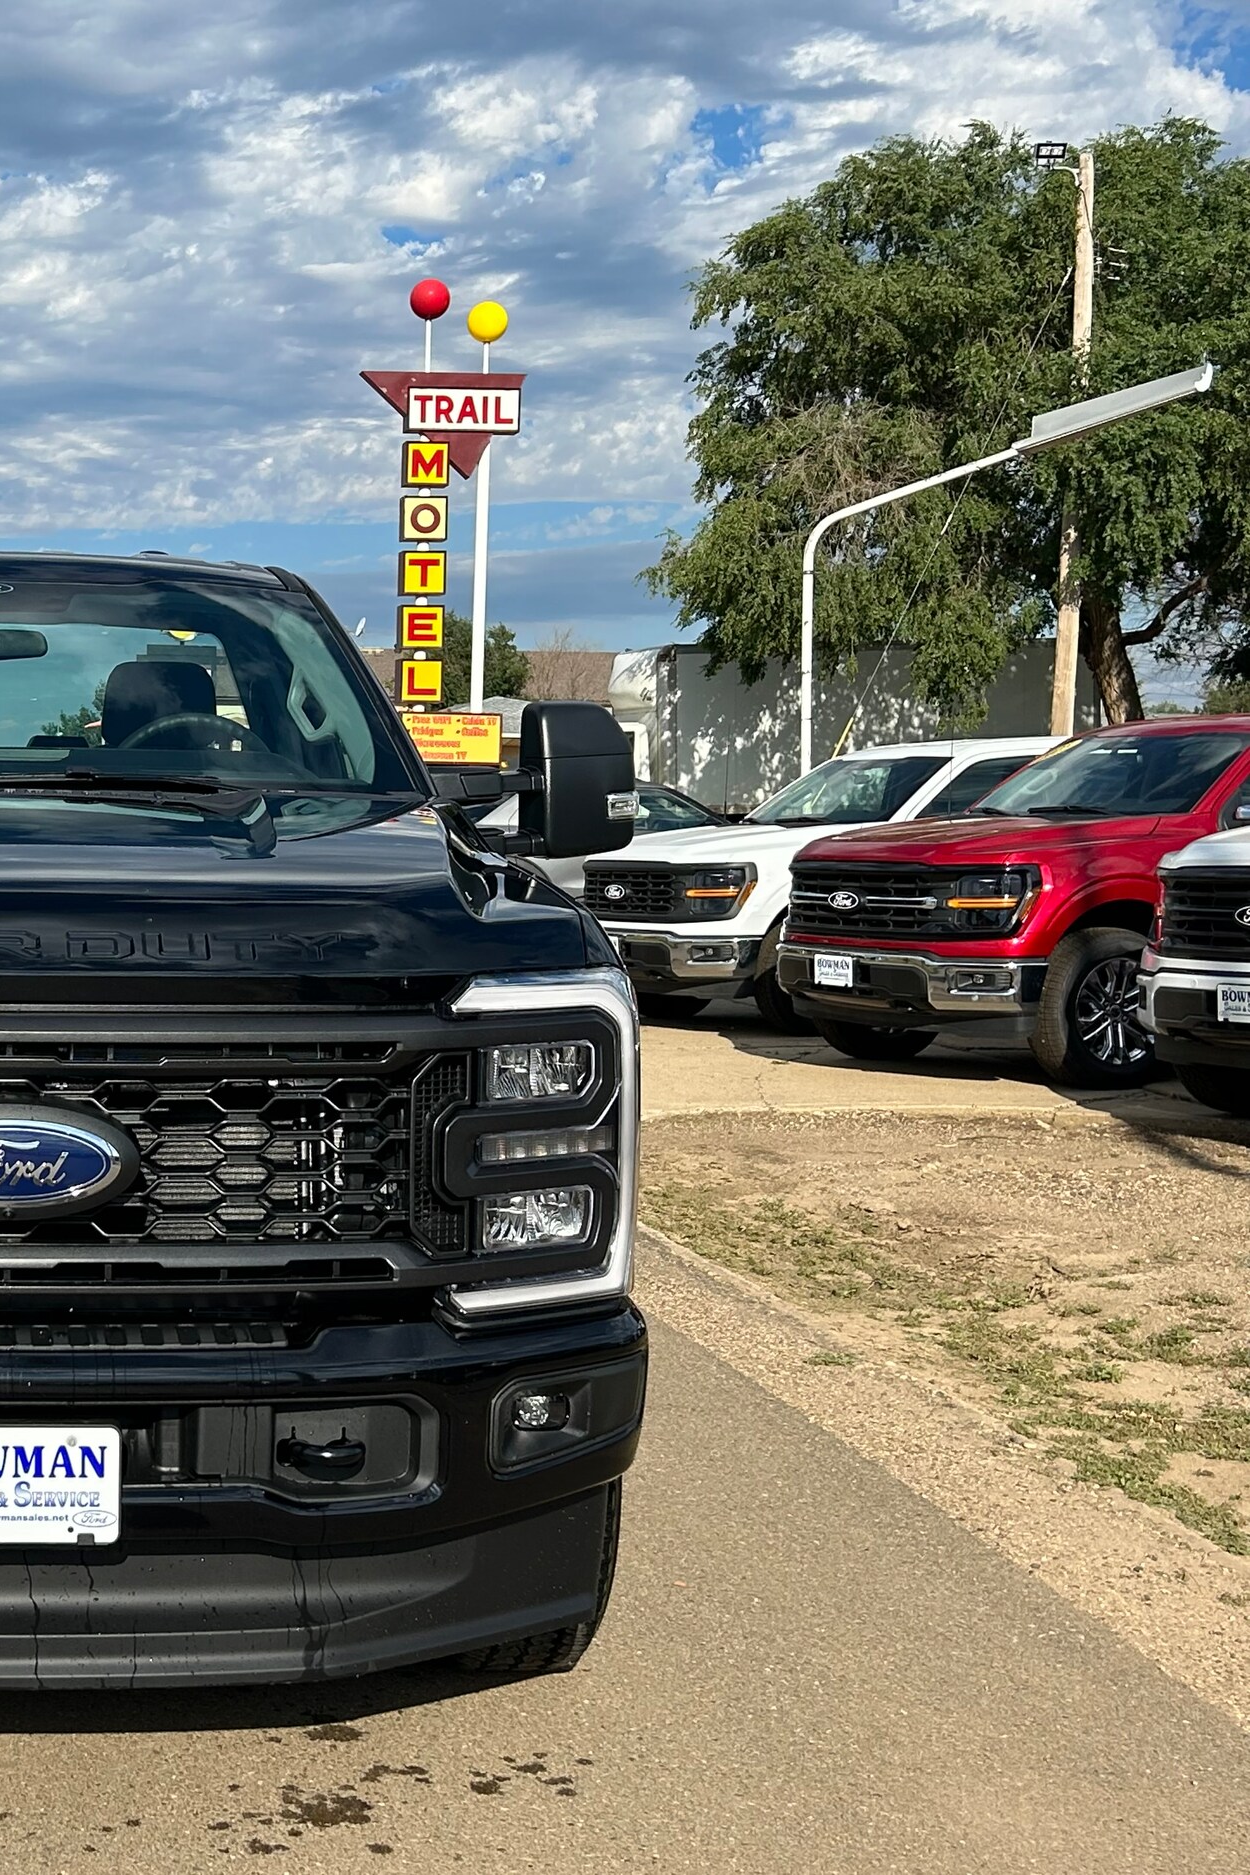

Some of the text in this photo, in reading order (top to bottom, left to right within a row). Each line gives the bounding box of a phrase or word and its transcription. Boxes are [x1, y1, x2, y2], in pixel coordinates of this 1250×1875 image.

[414, 395, 514, 424] TRAIL
[407, 449, 444, 696] MOTEL
[486, 717, 497, 726] TV
[456, 751, 467, 760] TV
[833, 893, 853, 906] Ford
[66, 929, 342, 961] DUTY
[80, 1512, 108, 1524] Ford
